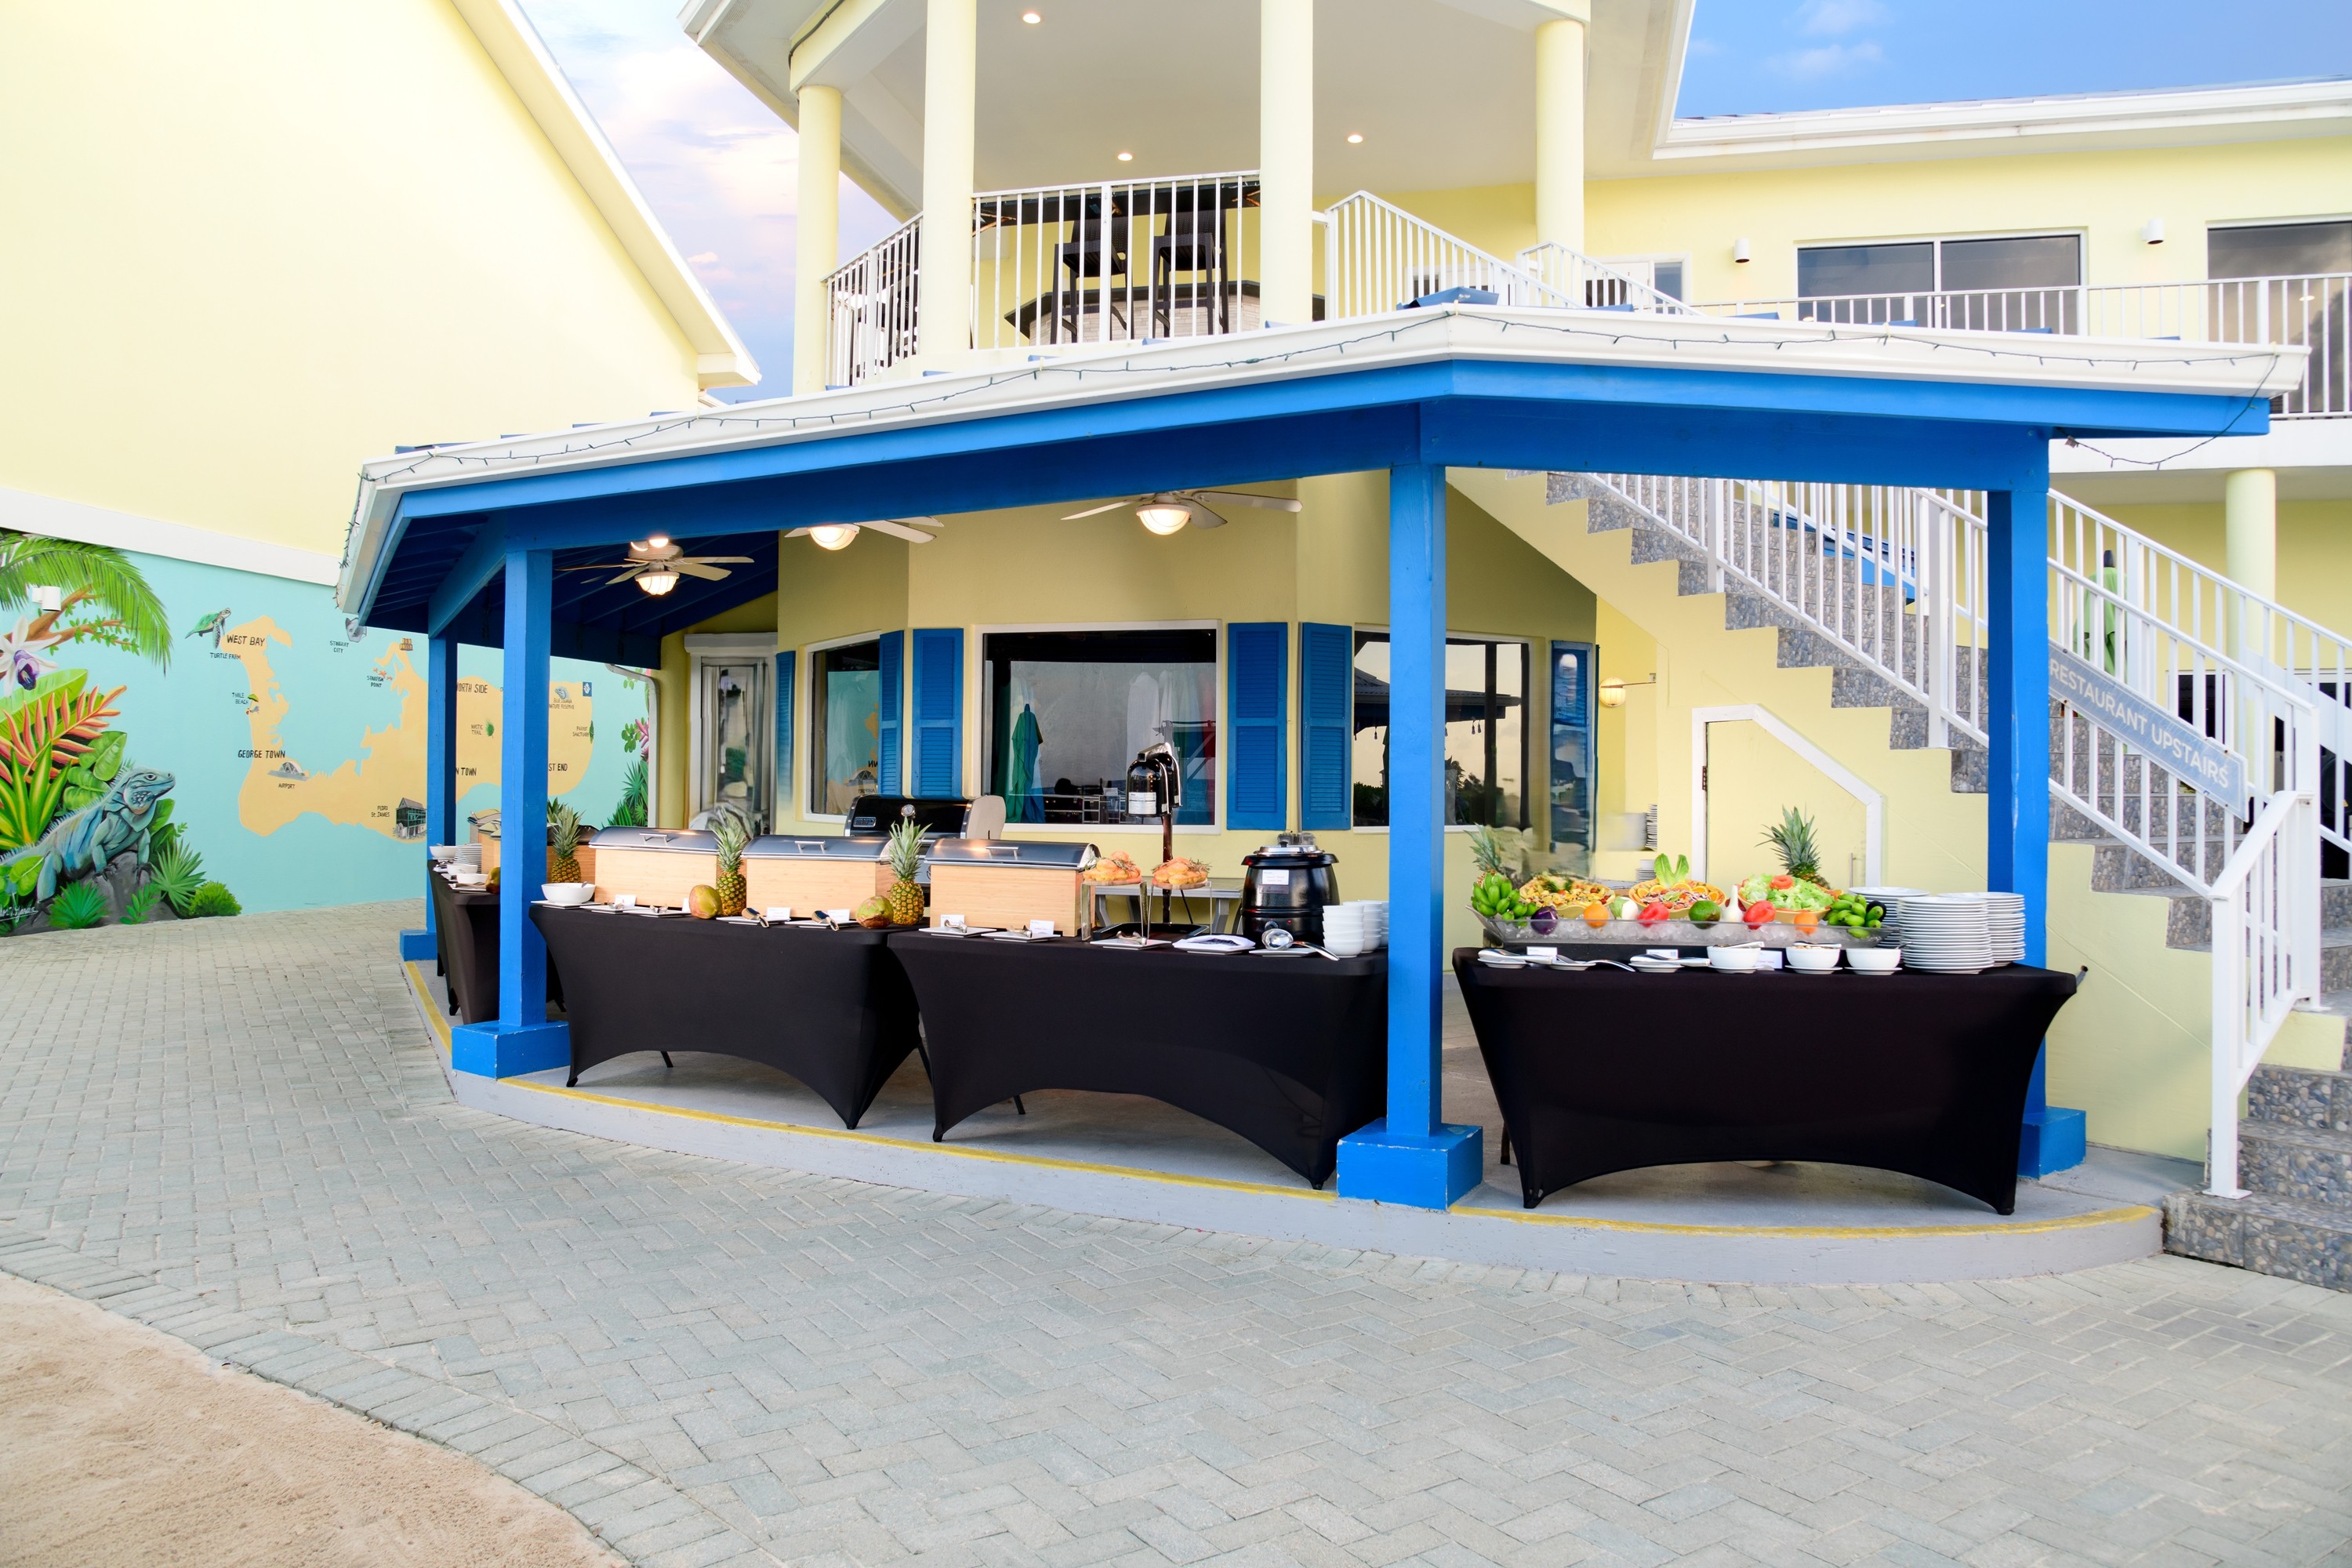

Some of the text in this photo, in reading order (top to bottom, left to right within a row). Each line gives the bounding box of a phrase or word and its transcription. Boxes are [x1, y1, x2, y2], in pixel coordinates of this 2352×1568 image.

[227, 634, 265, 647] WEST BAY
[474, 684, 488, 694] SIDE
[2049, 659, 2229, 789] RESTAURANT UPSTAIRS
[238, 750, 286, 759] GEORGE TOWN
[460, 767, 477, 776] TOWN
[557, 763, 568, 771] END
